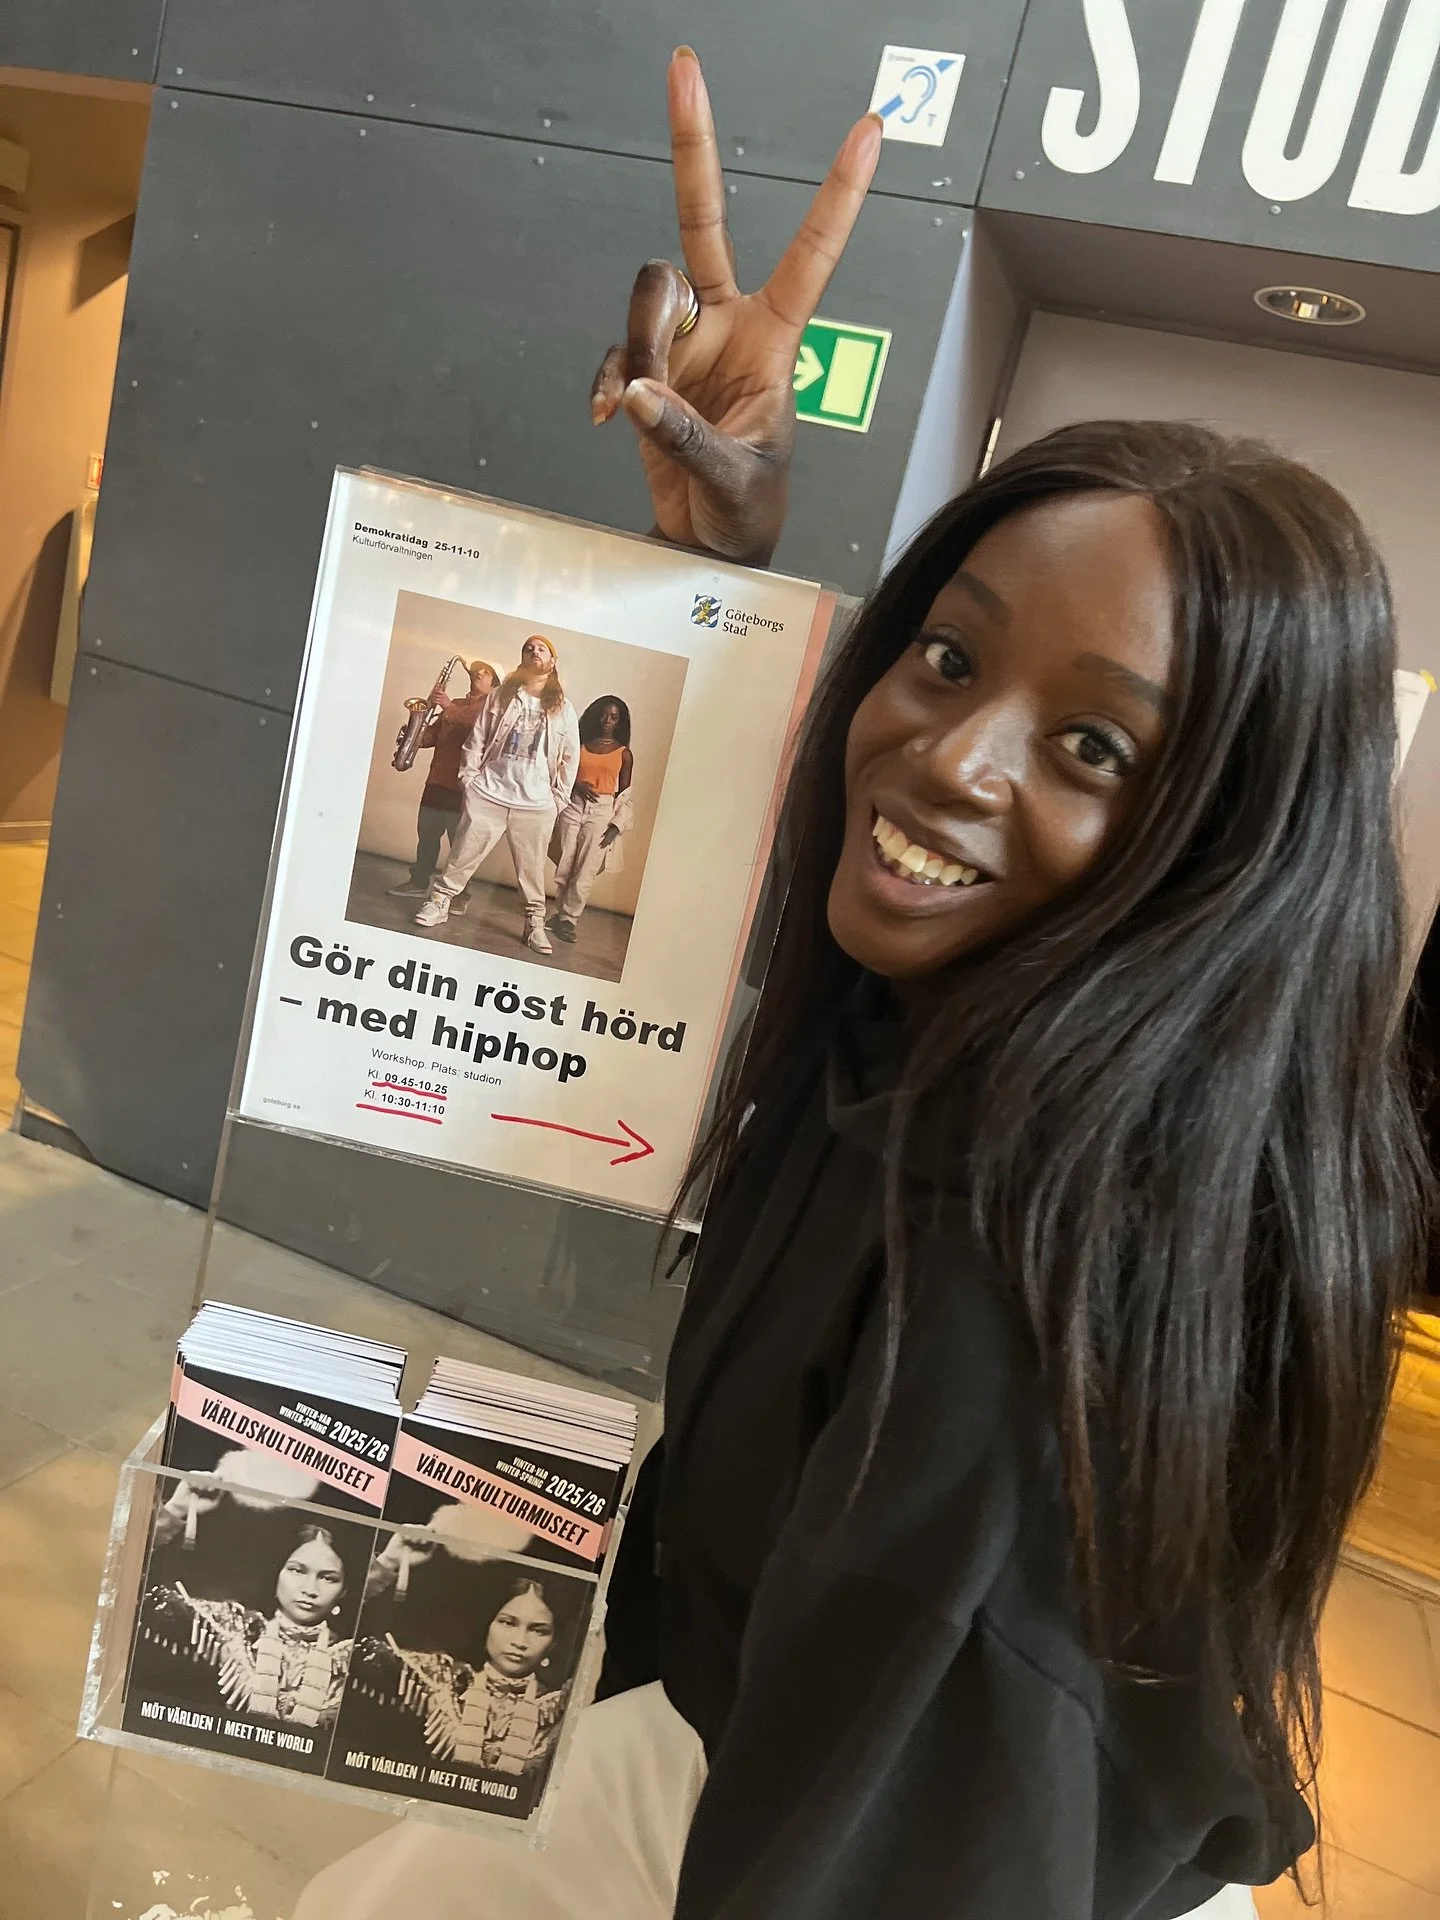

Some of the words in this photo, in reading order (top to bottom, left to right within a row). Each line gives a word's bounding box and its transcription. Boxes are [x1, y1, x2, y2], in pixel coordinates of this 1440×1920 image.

[352, 535, 433, 561] Kulturförvaltningen
[354, 522, 428, 548] Demokratidag
[434, 541, 480, 559] 25-11-10
[722, 621, 748, 636] Stad
[725, 608, 784, 633] Göteborgs
[289, 935, 375, 980] Gör
[387, 960, 458, 1001] din
[474, 982, 567, 1026] röst
[580, 1001, 687, 1053] hörd
[316, 997, 418, 1040] med
[431, 1016, 588, 1083] hiphop
[367, 1069, 381, 1080] Kl.
[384, 1073, 448, 1095] 09.45-10.25
[371, 1048, 427, 1069] Workshop.
[431, 1062, 461, 1077] Plats:
[463, 1069, 502, 1086] studion
[364, 1089, 377, 1100] Kl.
[382, 1094, 445, 1115] 10:30-11:10
[279, 1405, 328, 1435] WINTER-SPRING
[200, 1398, 375, 1493] VÄRLDSKULTURMUSEET
[329, 1421, 390, 1463] 2025/26
[495, 1460, 544, 1489] WINTER-SPRING
[415, 1453, 590, 1546] VÄRLDSKULTURMUSEET
[545, 1475, 606, 1516] 2025/26
[141, 1701, 166, 1721] MÖT
[167, 1706, 214, 1731] VÄRLDEN
[224, 1720, 254, 1741] MEET
[255, 1727, 275, 1745] THE
[276, 1731, 314, 1754] WORLD
[345, 1751, 370, 1769] MÖT
[371, 1756, 419, 1780] VÄRLDEN
[428, 1769, 458, 1788] MEET
[459, 1775, 480, 1793] THE
[480, 1779, 518, 1801] WORLD
